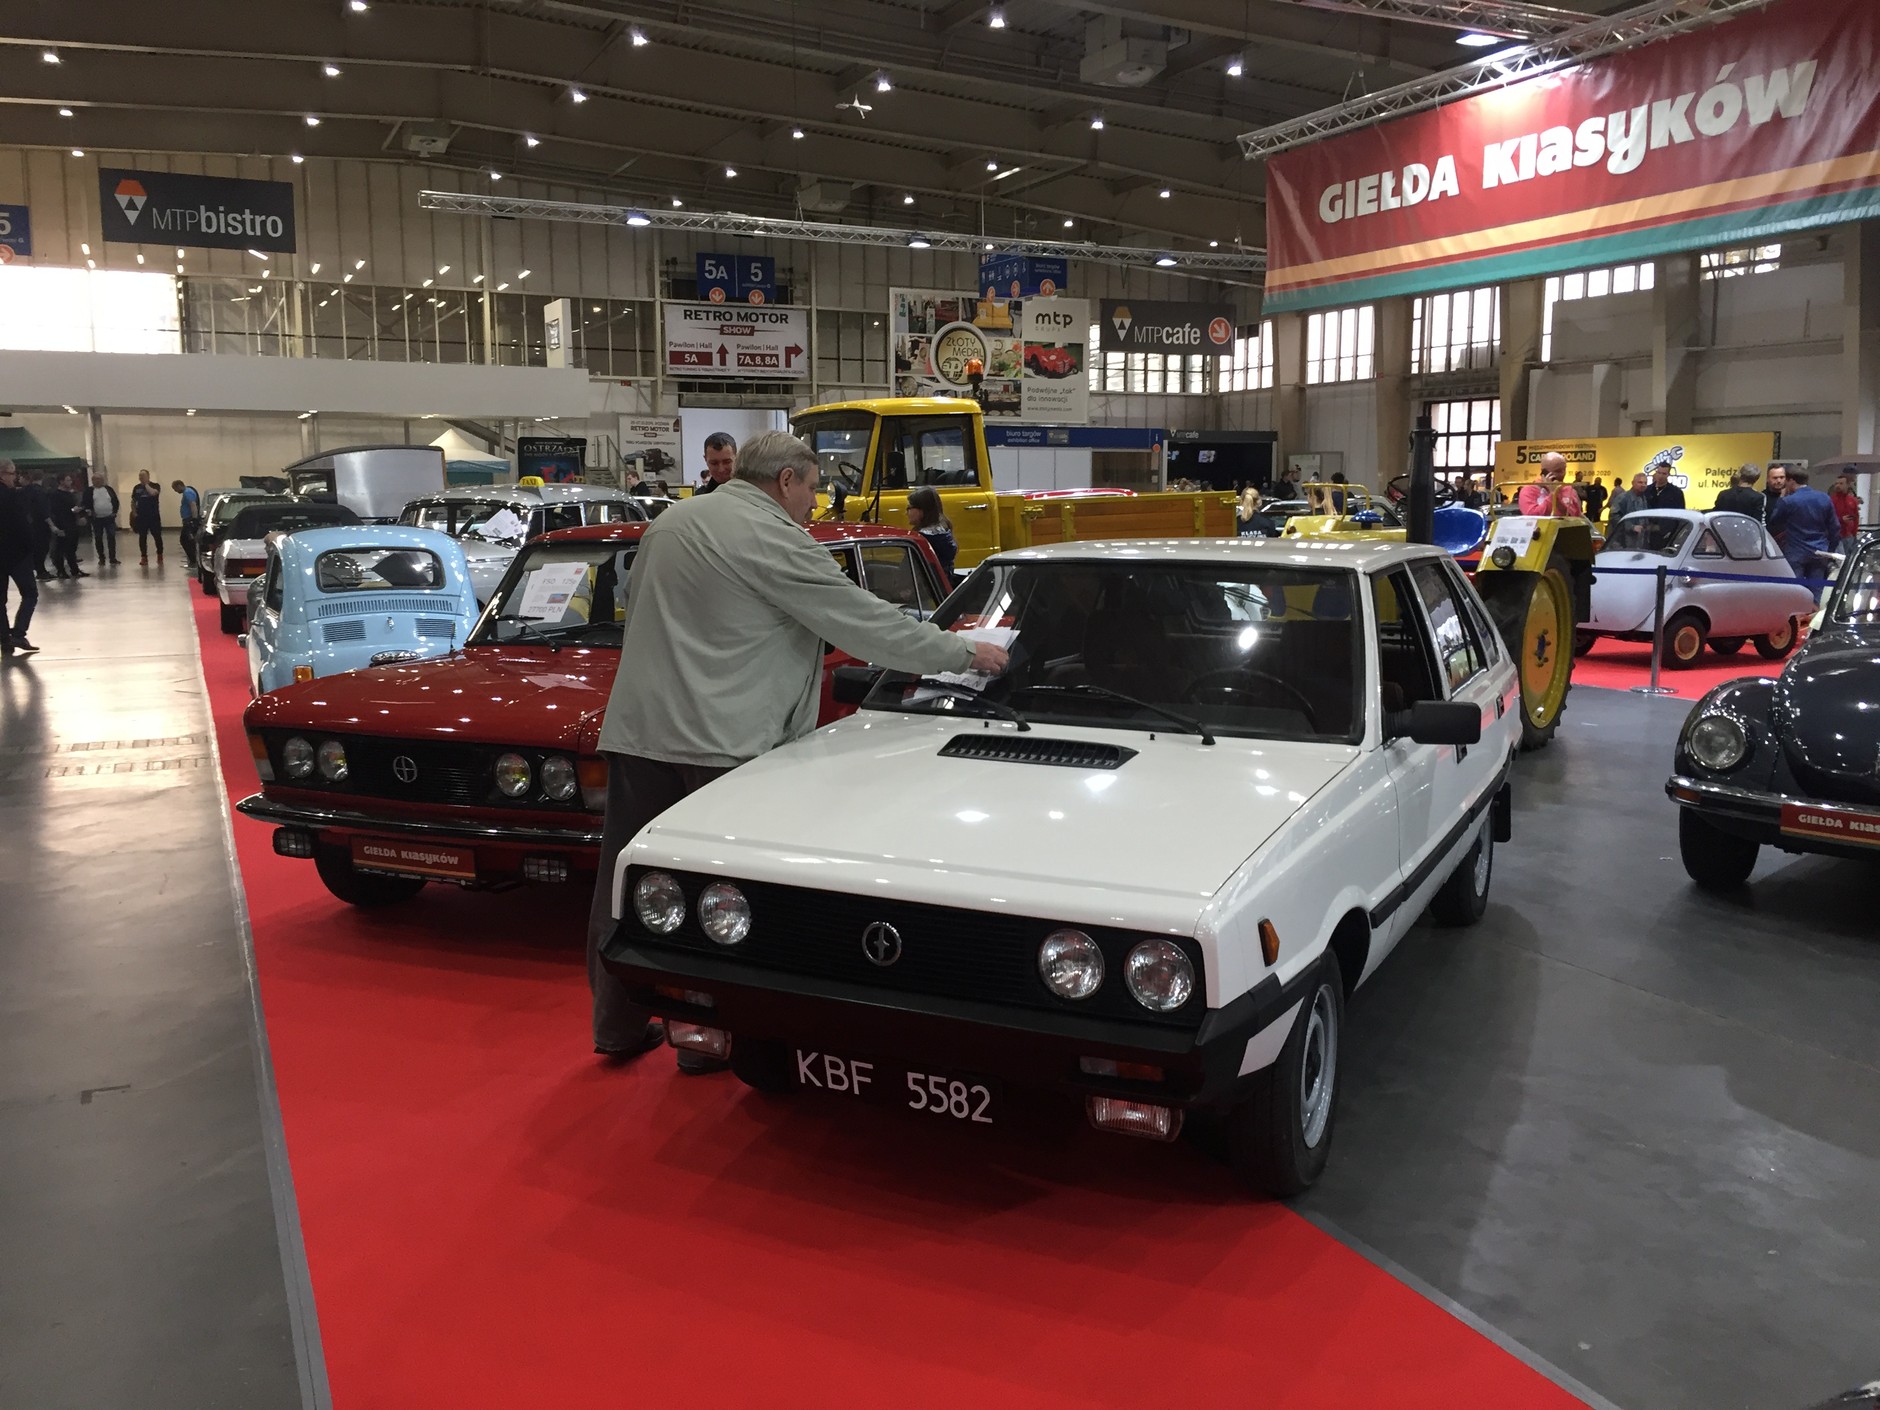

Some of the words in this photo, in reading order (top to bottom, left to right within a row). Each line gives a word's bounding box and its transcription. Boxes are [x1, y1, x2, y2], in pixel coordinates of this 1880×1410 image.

[1319, 154, 1459, 223] GIEŁDA
[1483, 59, 1818, 189] Klasyków
[152, 205, 283, 238] MTPbistro
[704, 260, 728, 280] 5A
[750, 262, 763, 282] 5
[683, 309, 733, 322] RETRO
[737, 311, 789, 324] MOTOR
[1035, 311, 1073, 328] mtp
[723, 326, 752, 335] SHOW
[1134, 323, 1201, 345] MTPcafe
[669, 341, 695, 349] Pawilon
[946, 336, 976, 347] ZŁOTY
[684, 353, 698, 363] 5A
[952, 347, 983, 358] MEDAL
[738, 355, 754, 365] 7A,
[755, 356, 763, 365] 8,
[765, 356, 778, 366] 8A
[1516, 445, 1528, 464] 5
[1798, 814, 1843, 828] GIEŁDA
[363, 845, 397, 858] GIEŁDA
[796, 1049, 874, 1095] KBF
[907, 1071, 993, 1124] 5582
